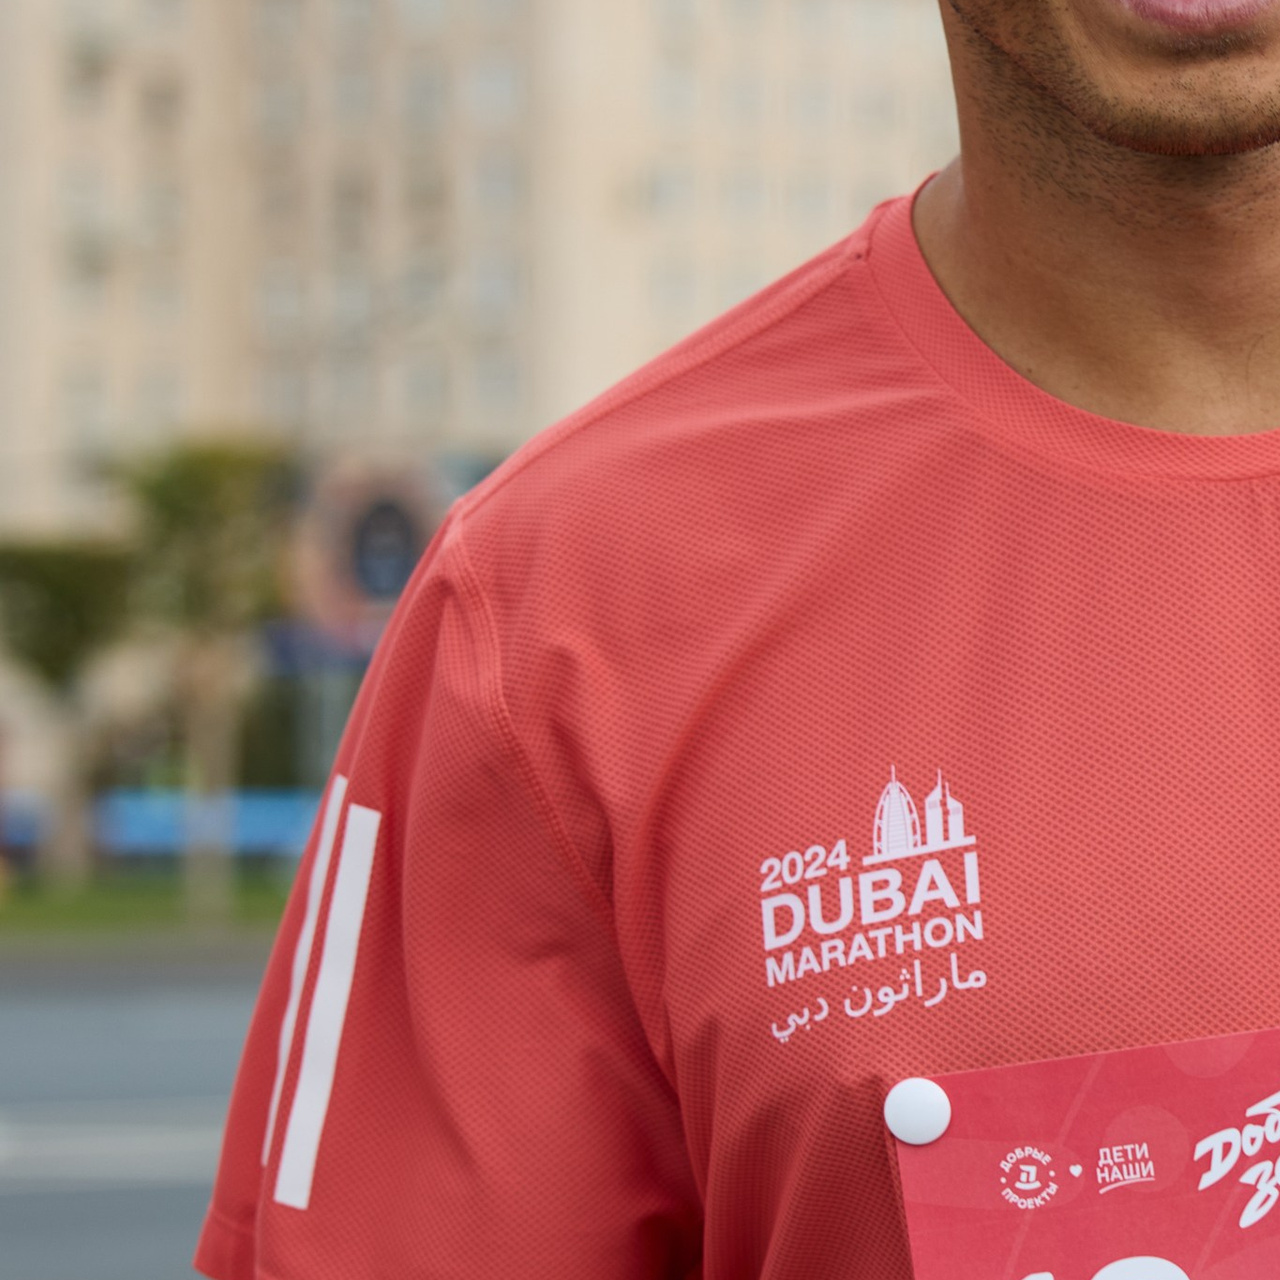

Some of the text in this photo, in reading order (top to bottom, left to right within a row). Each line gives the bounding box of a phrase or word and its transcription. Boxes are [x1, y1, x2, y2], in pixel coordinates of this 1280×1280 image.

[761, 839, 850, 892] 2024
[760, 851, 981, 951] DUBAI
[765, 910, 984, 987] MARATHON
[772, 952, 987, 1043] ماراثون دبي
[1000, 1146, 1052, 1173] ДОБРЫЕ
[1096, 1160, 1155, 1184] НАШИ
[1098, 1142, 1149, 1167] ДЕТИ
[1002, 1182, 1059, 1209] ПРОЕКТЫ
